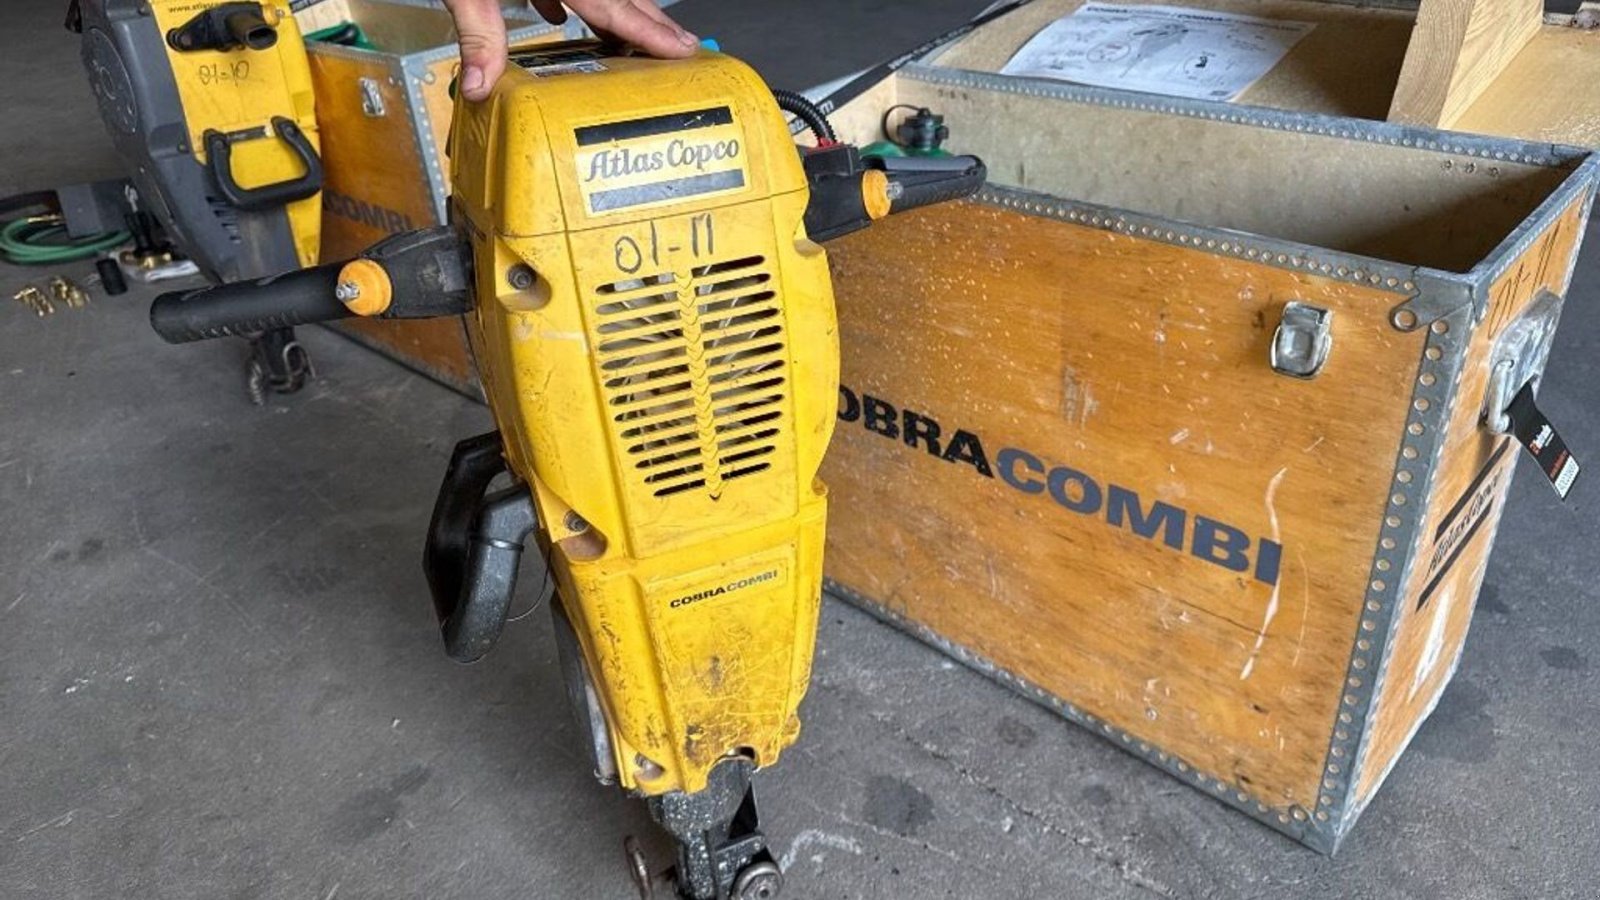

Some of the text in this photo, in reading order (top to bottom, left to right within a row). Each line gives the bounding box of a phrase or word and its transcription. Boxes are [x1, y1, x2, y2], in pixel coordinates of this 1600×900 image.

[585, 138, 740, 183] Atlas Copco
[323, 188, 413, 233] COMBI
[614, 213, 714, 274] 01-11
[838, 384, 1283, 587] OBRACOMBI
